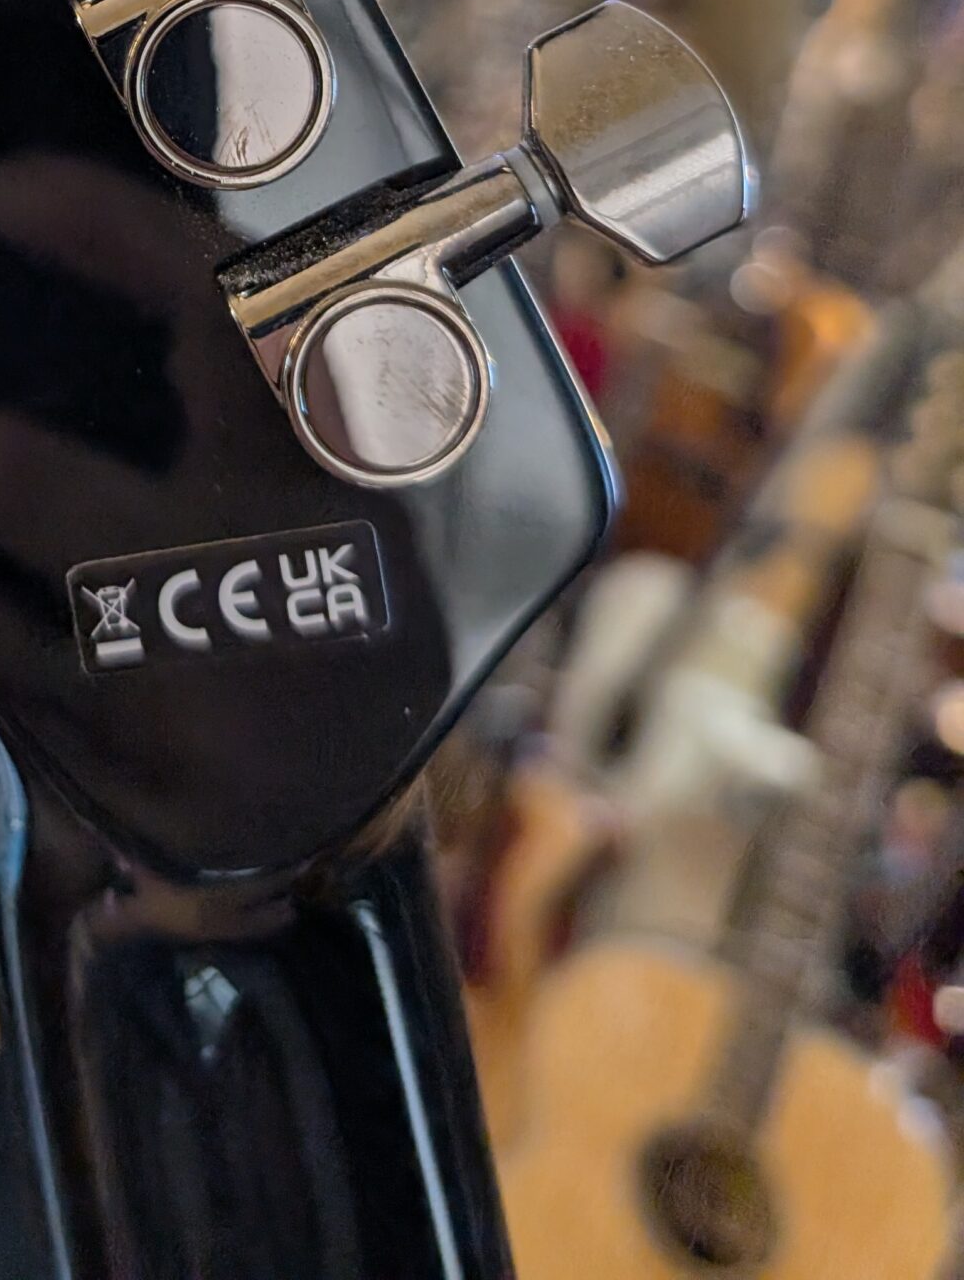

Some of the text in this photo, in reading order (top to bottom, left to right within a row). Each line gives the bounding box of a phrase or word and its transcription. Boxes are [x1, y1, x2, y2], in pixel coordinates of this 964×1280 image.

[279, 543, 360, 589] UK
[158, 561, 271, 646] CE
[287, 583, 368, 633] CA
